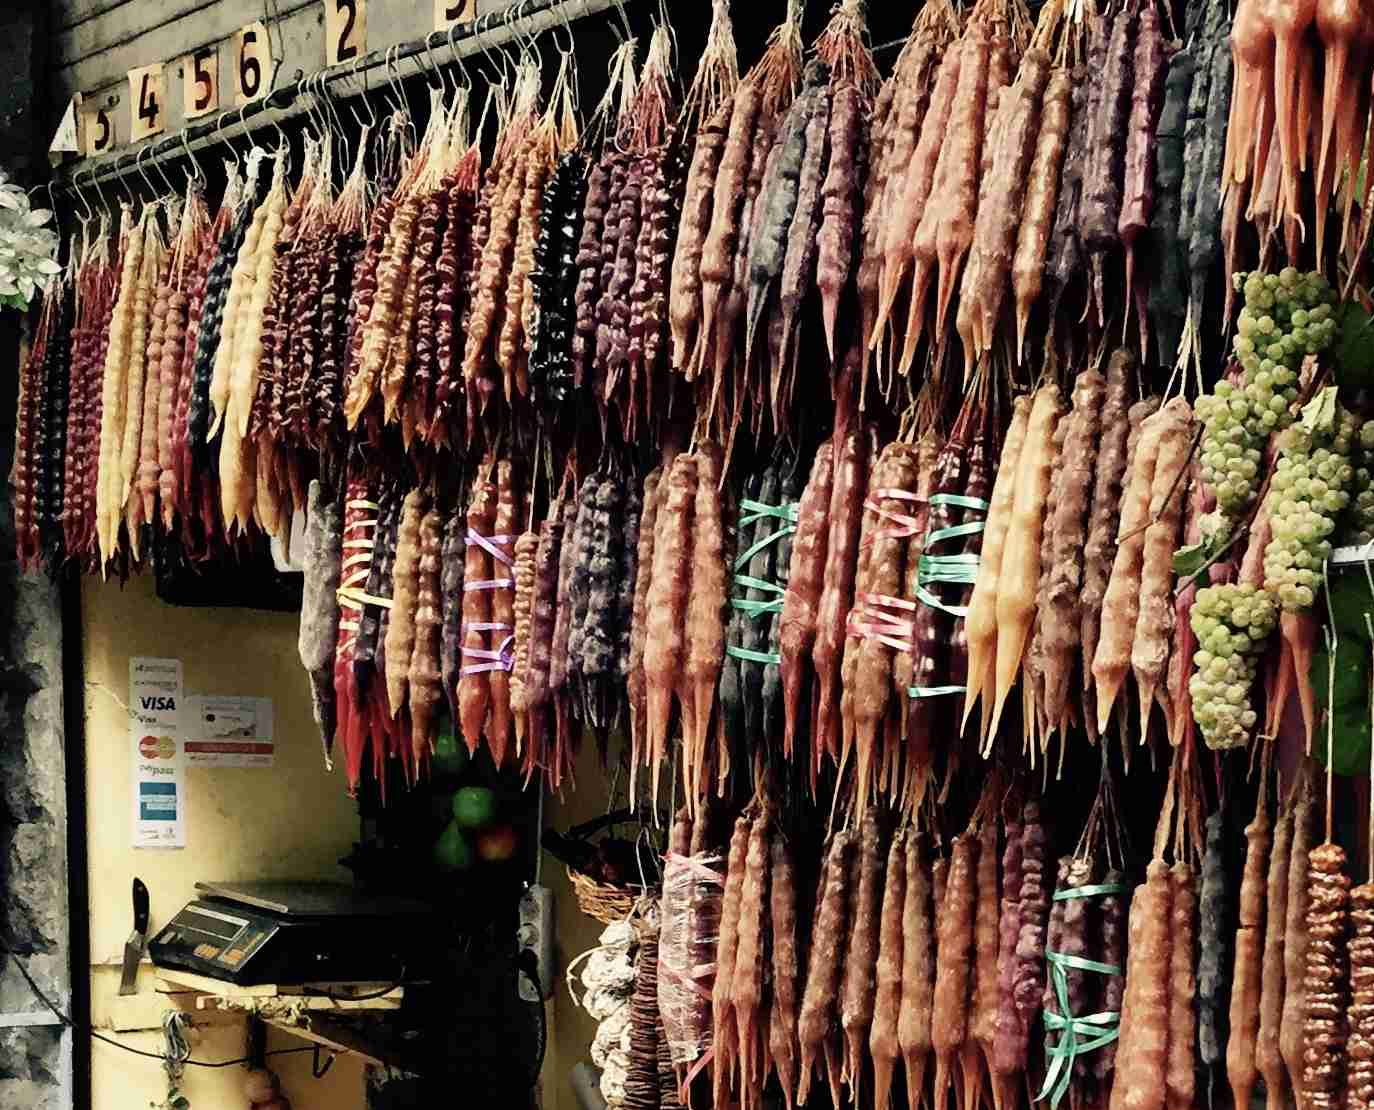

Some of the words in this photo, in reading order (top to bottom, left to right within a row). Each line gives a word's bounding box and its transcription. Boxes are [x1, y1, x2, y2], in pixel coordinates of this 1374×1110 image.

[336, 0, 357, 62] 2
[139, 73, 159, 128] 4
[194, 47, 212, 111] 5
[240, 31, 260, 98] 6
[139, 696, 176, 710] VISA
